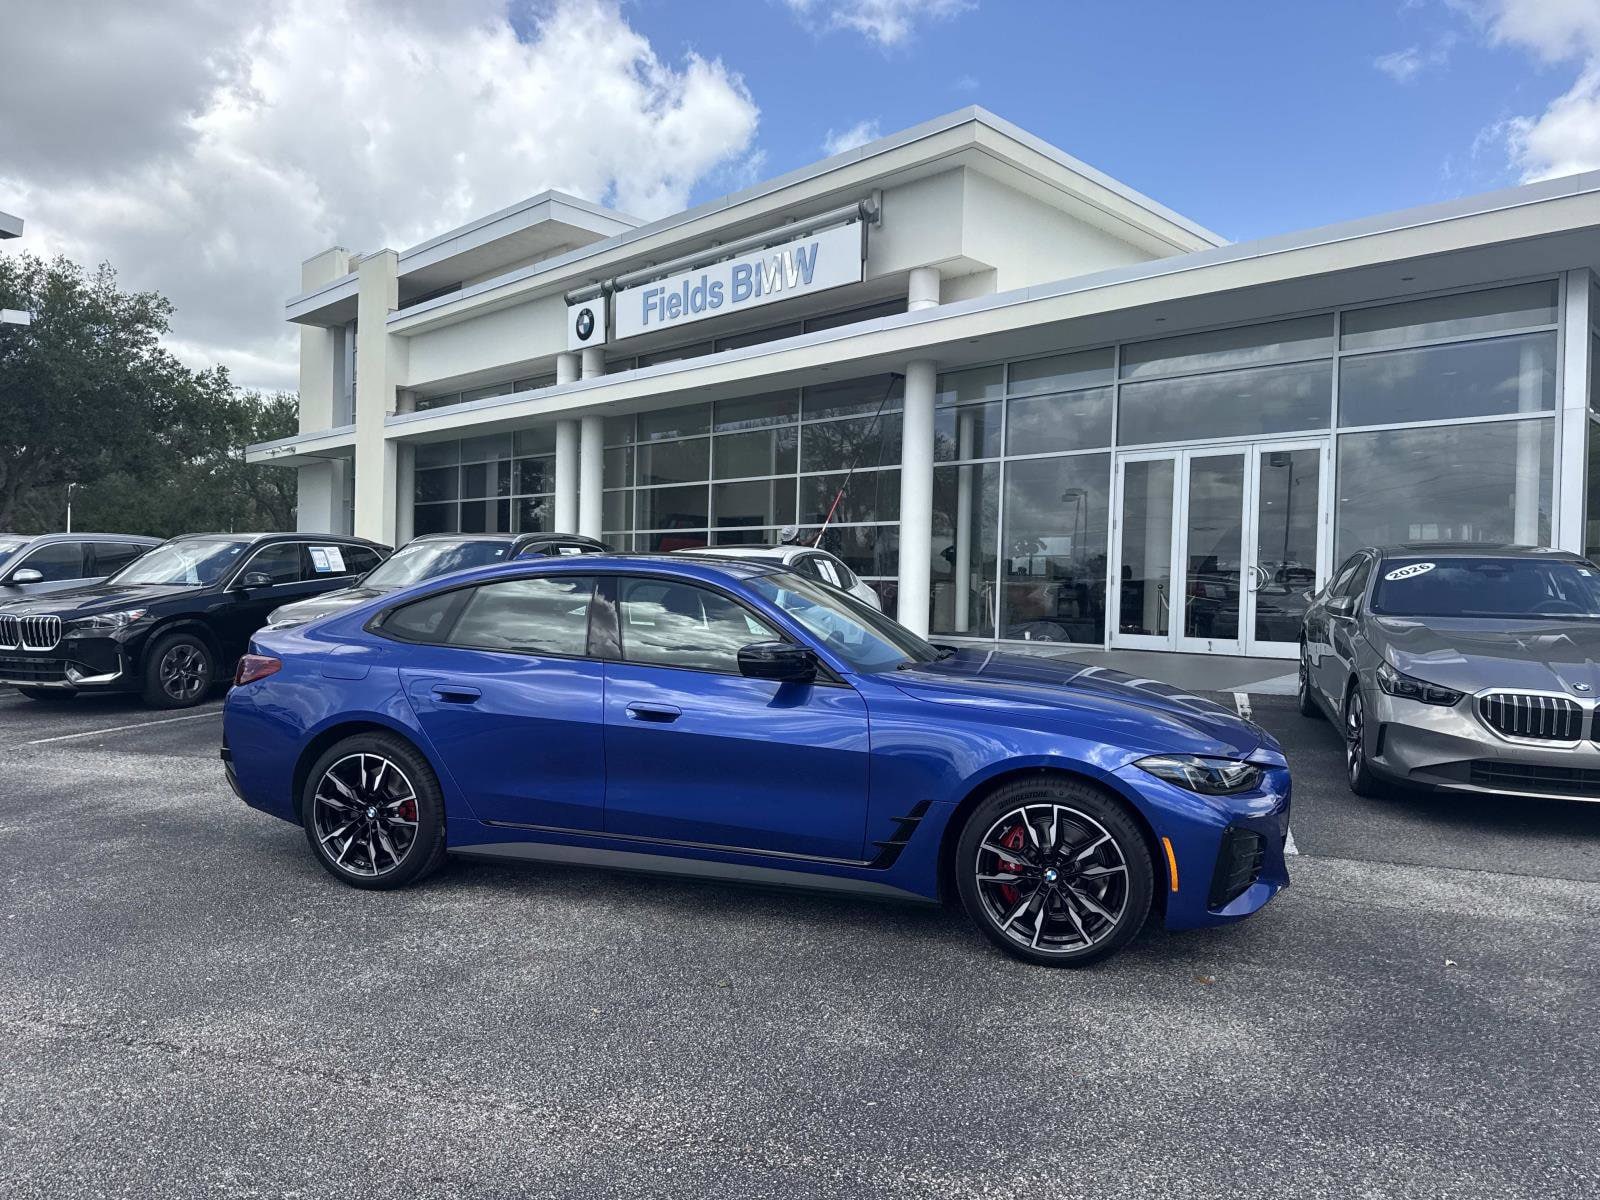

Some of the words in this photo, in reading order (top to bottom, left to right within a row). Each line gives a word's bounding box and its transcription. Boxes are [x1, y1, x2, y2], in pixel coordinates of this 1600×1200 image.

[642, 275, 724, 325] Fields
[731, 242, 819, 303] BMW
[1389, 563, 1431, 579] 2026
